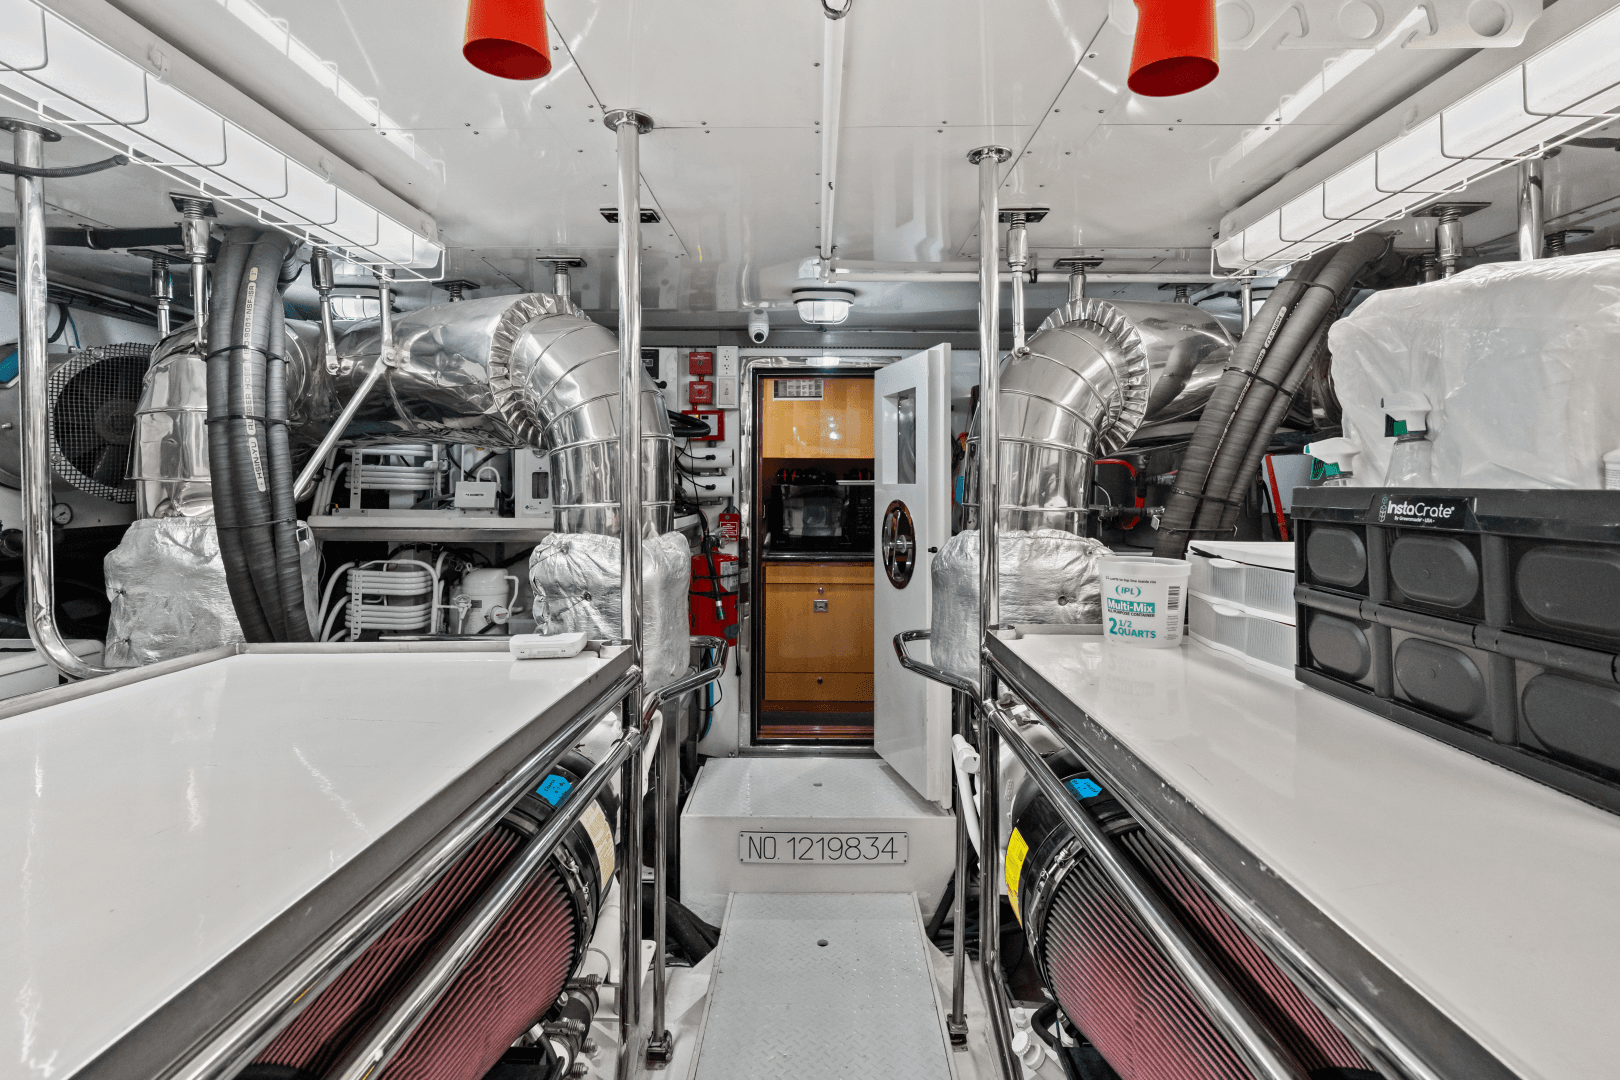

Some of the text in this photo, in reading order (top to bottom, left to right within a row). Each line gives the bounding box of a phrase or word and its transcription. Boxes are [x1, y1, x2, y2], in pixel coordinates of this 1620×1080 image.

[250, 442, 262, 479] HSIN-YU
[1387, 500, 1452, 518] InstaCrate
[1107, 598, 1153, 613] Multi-Mix
[1108, 618, 1117, 635] 2
[1118, 628, 1156, 638] QUARTS
[749, 836, 898, 860] NO. 1219834
